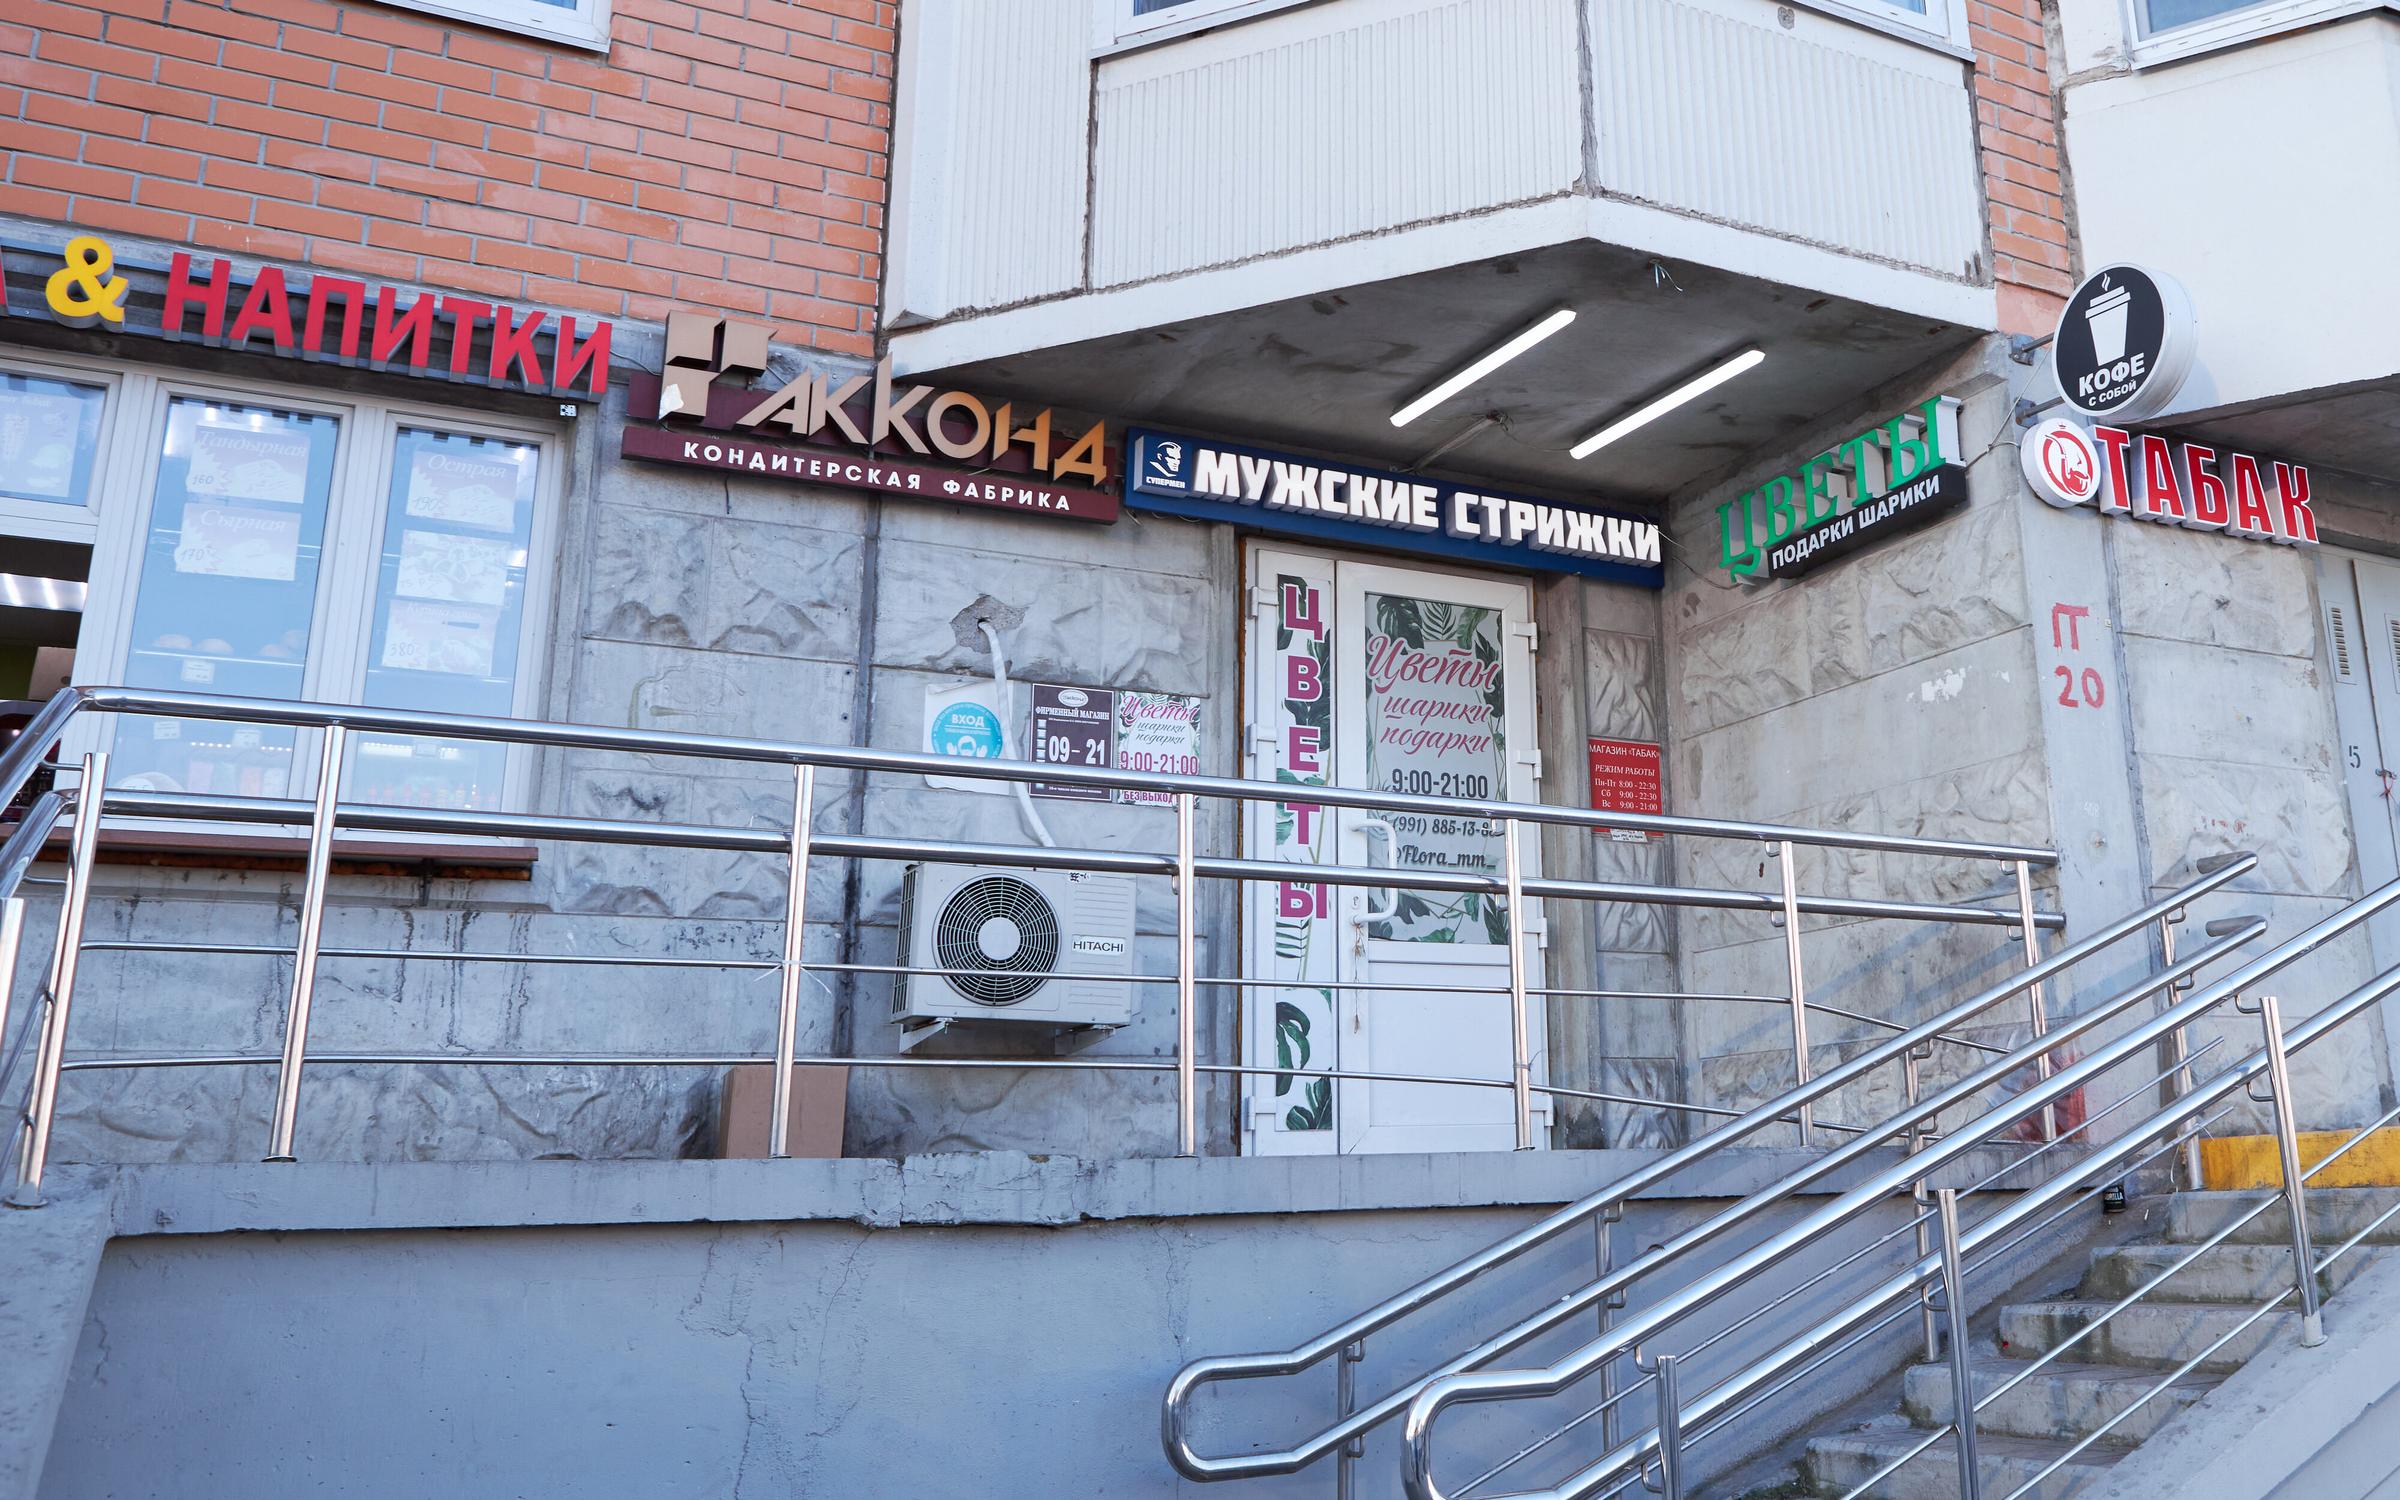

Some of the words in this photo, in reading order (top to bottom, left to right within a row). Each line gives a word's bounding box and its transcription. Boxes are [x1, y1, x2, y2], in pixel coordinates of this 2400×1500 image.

[161, 251, 612, 395] НАПИТКИ
[2079, 352, 2145, 397] КОФЕ
[2099, 379, 2137, 403] СОБОЙ
[736, 352, 1108, 486] АККОНД
[428, 454, 507, 478] Острая
[684, 440, 921, 490] КОНДИТЕРСКАЯ
[942, 478, 1070, 511] ФАБРИКА
[1145, 476, 1186, 489] СУПЕРМЕН
[1715, 395, 1948, 583] ЦВЕТЫ
[2094, 424, 2320, 544] ТАБАК
[1194, 448, 1440, 530] МУЖСКИЕ
[1452, 491, 1662, 565] СТРИЖКИ
[201, 509, 287, 532] Сырная
[1771, 515, 1854, 570] ПОДАРКИ
[1858, 474, 1941, 529] ШАРИКИ
[2051, 602, 2089, 651] П
[1368, 635, 1500, 694] Цветы
[2054, 665, 2105, 709] 20
[951, 713, 985, 728] ВХОД
[1035, 706, 1079, 718] ФИРМЕННЫЙ
[1079, 709, 1110, 720] МАГАЗИН
[1122, 695, 1199, 725] Цветы
[1383, 696, 1492, 726] шарики
[1136, 734, 1185, 746] подарки
[1137, 722, 1186, 734] шарики
[1085, 738, 1105, 765] 21
[1279, 584, 1328, 920] ЦВЕТЫ
[1380, 727, 1491, 758] подарки
[1589, 744, 1627, 756] МАГАЗИН
[1120, 751, 1199, 776] 9:00-21:00
[2349, 745, 2361, 768] 5
[1595, 764, 1624, 774] РЕЖИМ
[1625, 767, 1655, 777] РАБОТЫ
[1123, 790, 1140, 801] БЕЗ
[1392, 768, 1489, 799] 9:00-21:00
[1594, 778, 1616, 788] Пн-Пт
[1618, 780, 1633, 789] 8:00
[1639, 782, 1657, 791] 22:30
[1601, 789, 1612, 797] Сб
[1619, 790, 1634, 799] 9:00
[1639, 792, 1657, 801] 22:30
[1602, 799, 1612, 808] Вс
[1619, 800, 1635, 809] 9:00
[1640, 802, 1658, 811] 21:00
[1392, 815, 1427, 836] (991)
[1073, 940, 1124, 953] HITACHI
